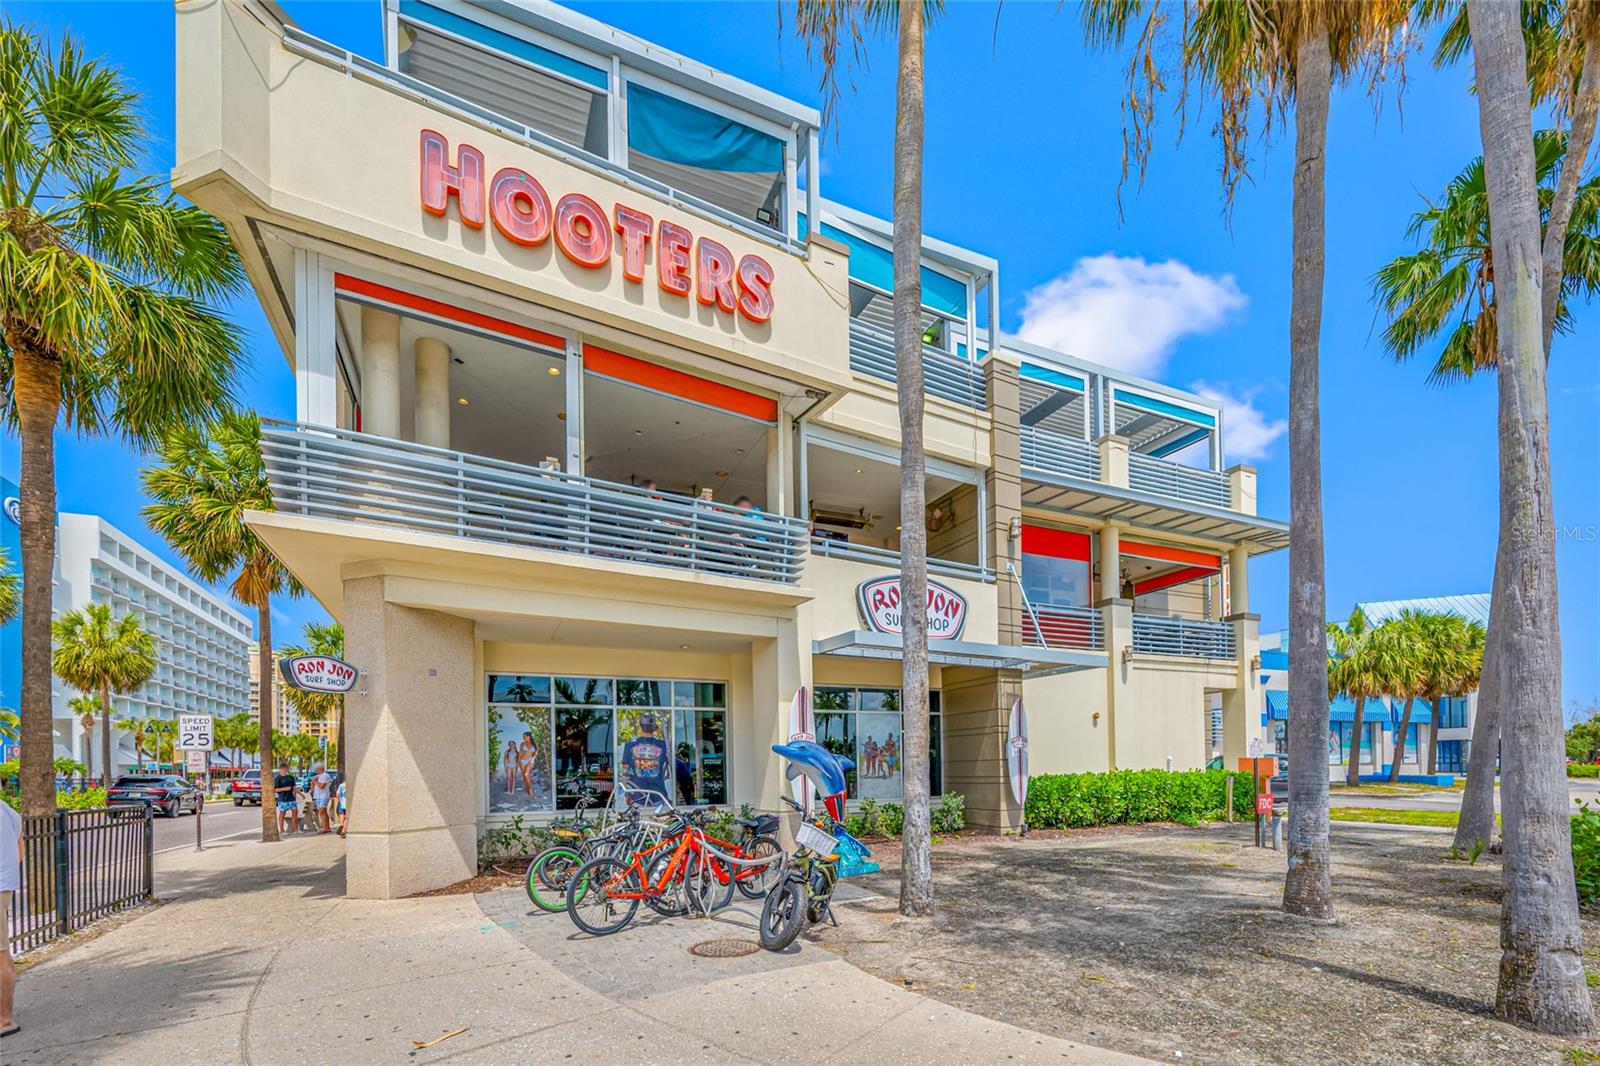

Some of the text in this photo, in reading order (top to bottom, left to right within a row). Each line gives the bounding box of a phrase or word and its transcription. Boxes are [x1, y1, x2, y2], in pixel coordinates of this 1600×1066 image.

[420, 128, 774, 323] HOOTERS
[873, 585, 902, 613] RO
[926, 618, 950, 632] HOP
[297, 660, 353, 680] RON JON
[304, 674, 346, 686] SURF SHOP
[182, 733, 210, 746] 25
[1258, 798, 1272, 809] FDC
